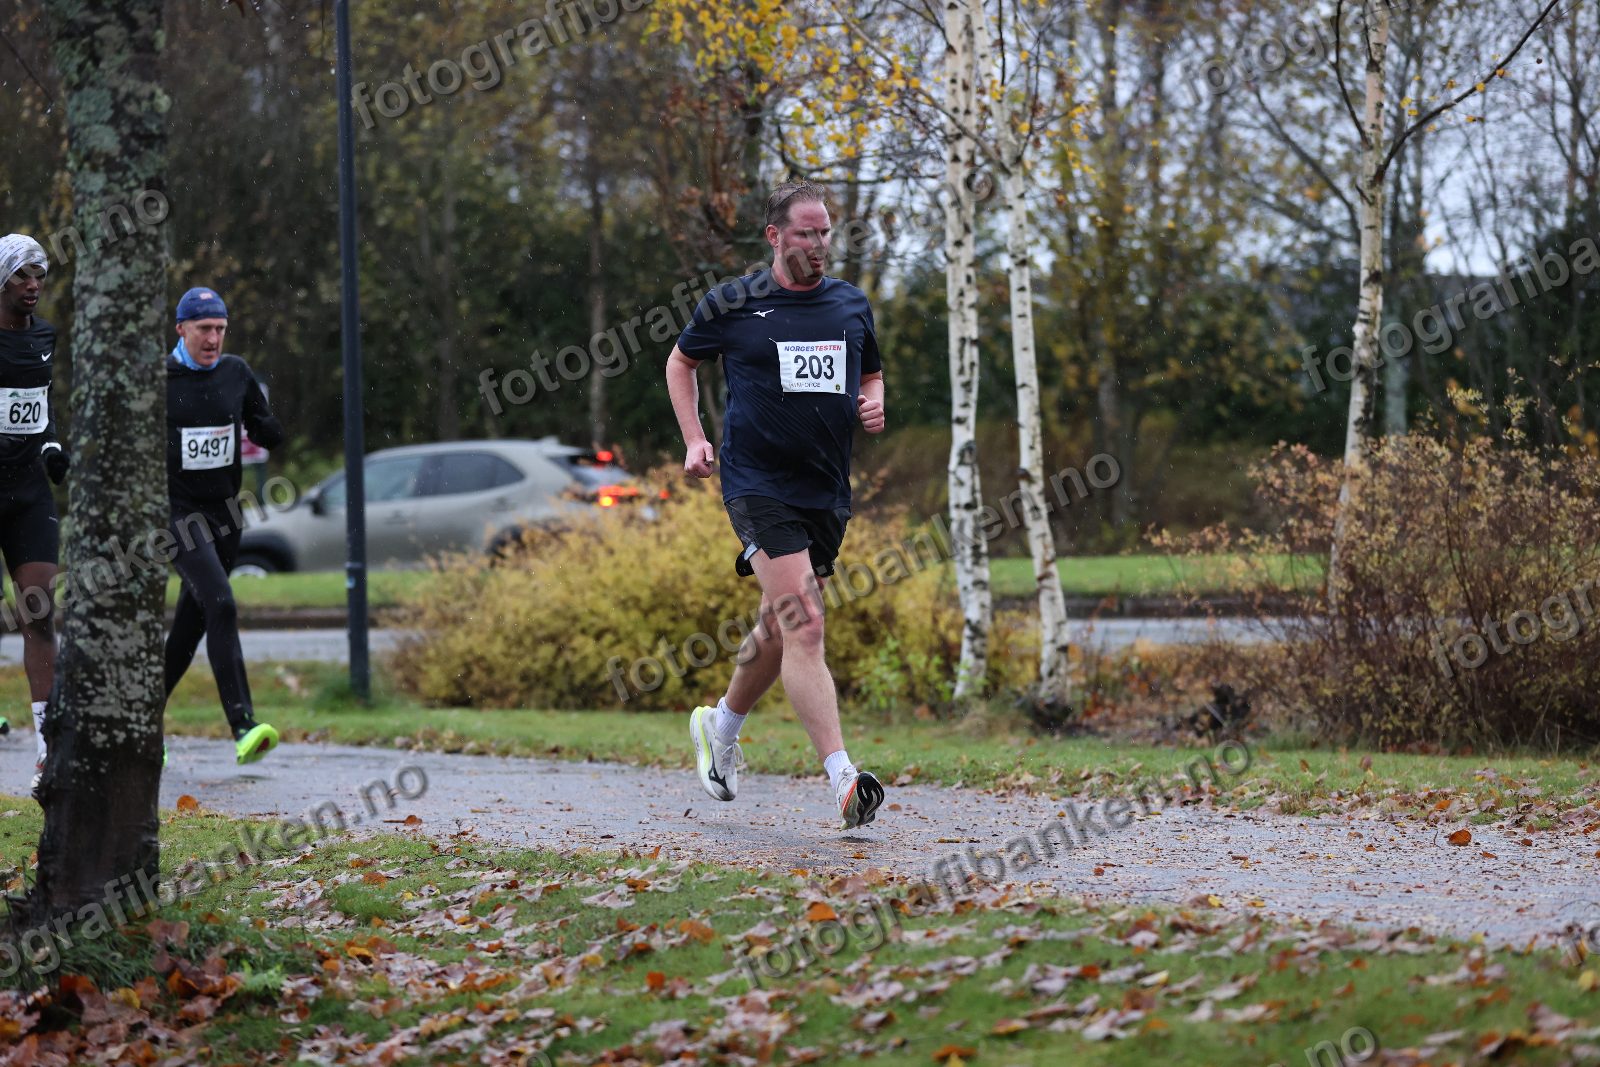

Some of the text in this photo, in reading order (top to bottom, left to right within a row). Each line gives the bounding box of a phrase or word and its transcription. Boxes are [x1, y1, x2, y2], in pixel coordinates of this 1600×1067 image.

[793, 354, 835, 380] 203
[9, 401, 41, 424] 620
[187, 436, 229, 459] 9497
